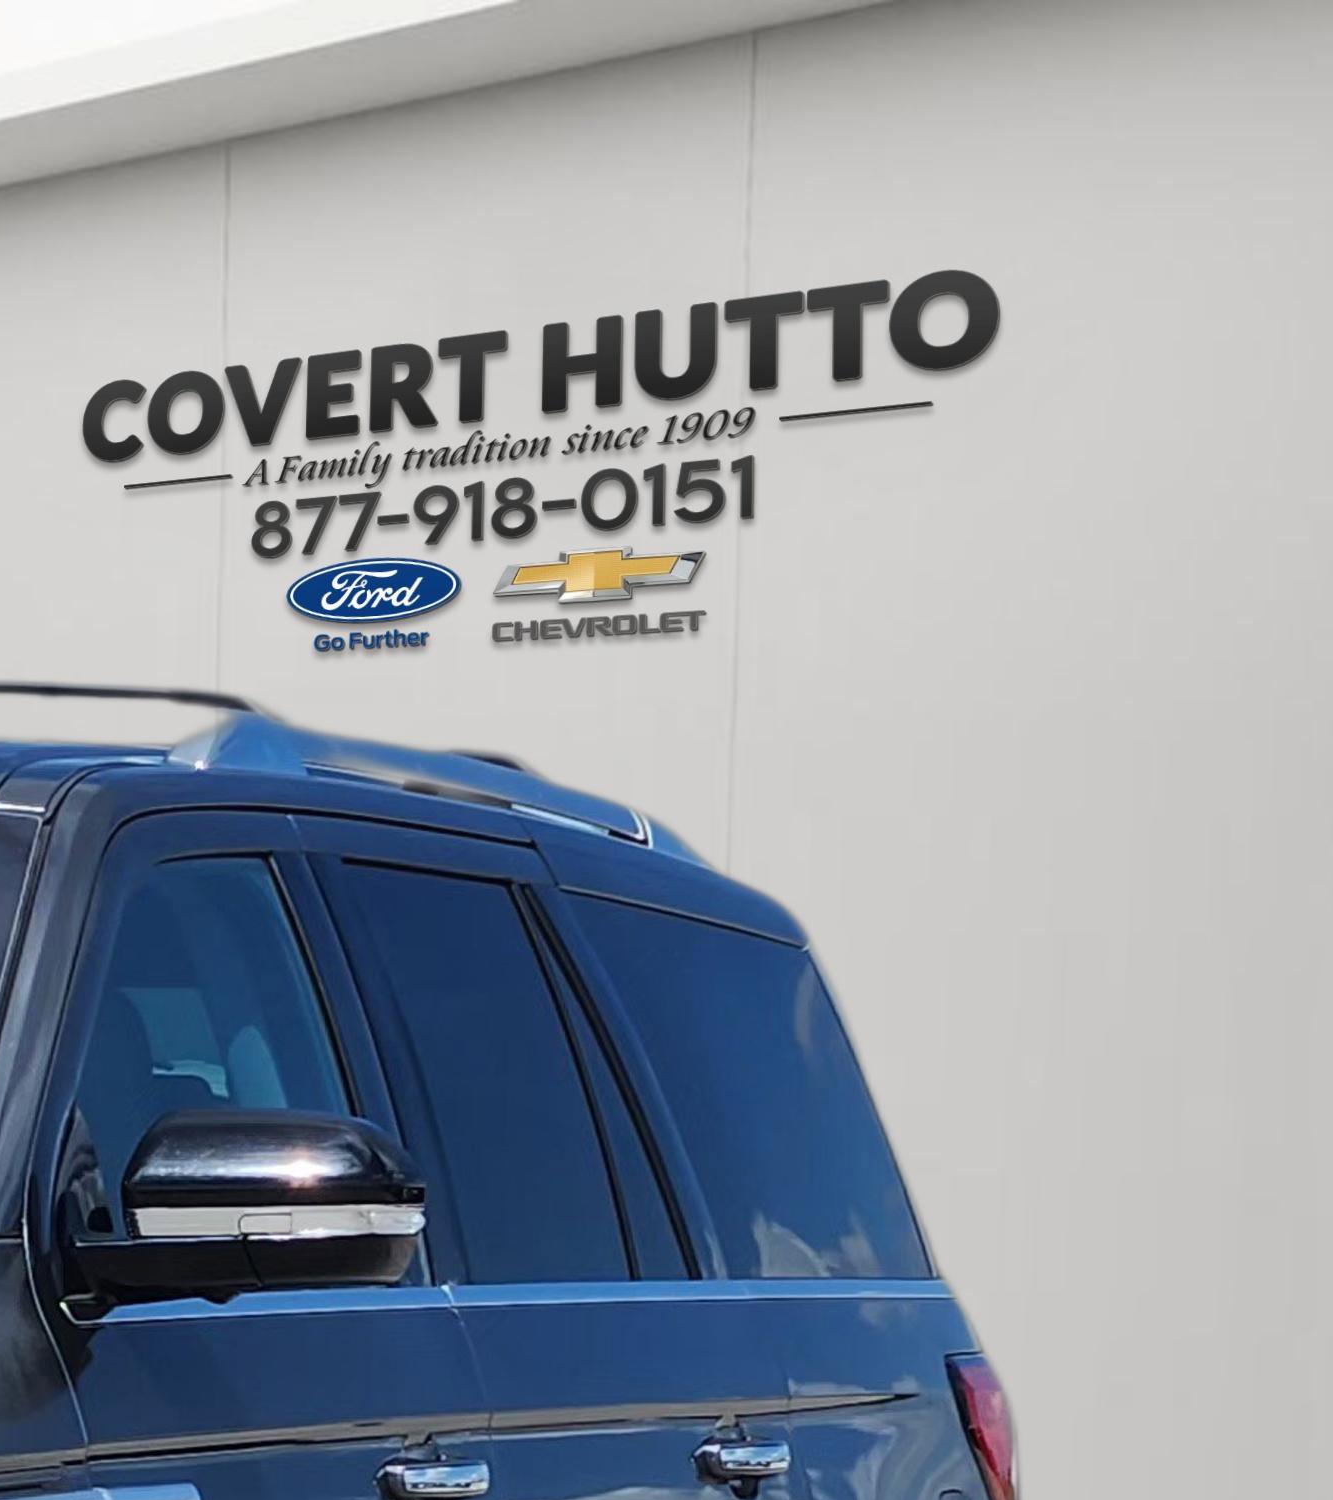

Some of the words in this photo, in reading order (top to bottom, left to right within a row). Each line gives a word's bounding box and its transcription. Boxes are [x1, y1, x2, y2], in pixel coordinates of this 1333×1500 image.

[83, 331, 508, 464] COVERT
[542, 270, 1000, 415] HUTTO
[243, 459, 269, 487] A
[275, 441, 392, 489] Family
[403, 430, 551, 471] tradition
[562, 425, 649, 455] since
[658, 407, 755, 445] 1909
[251, 455, 754, 559] 877-918-0151
[320, 567, 421, 612] Ford
[314, 633, 345, 653] Go
[349, 627, 429, 651] Further
[491, 610, 707, 643] CHEVROLET
